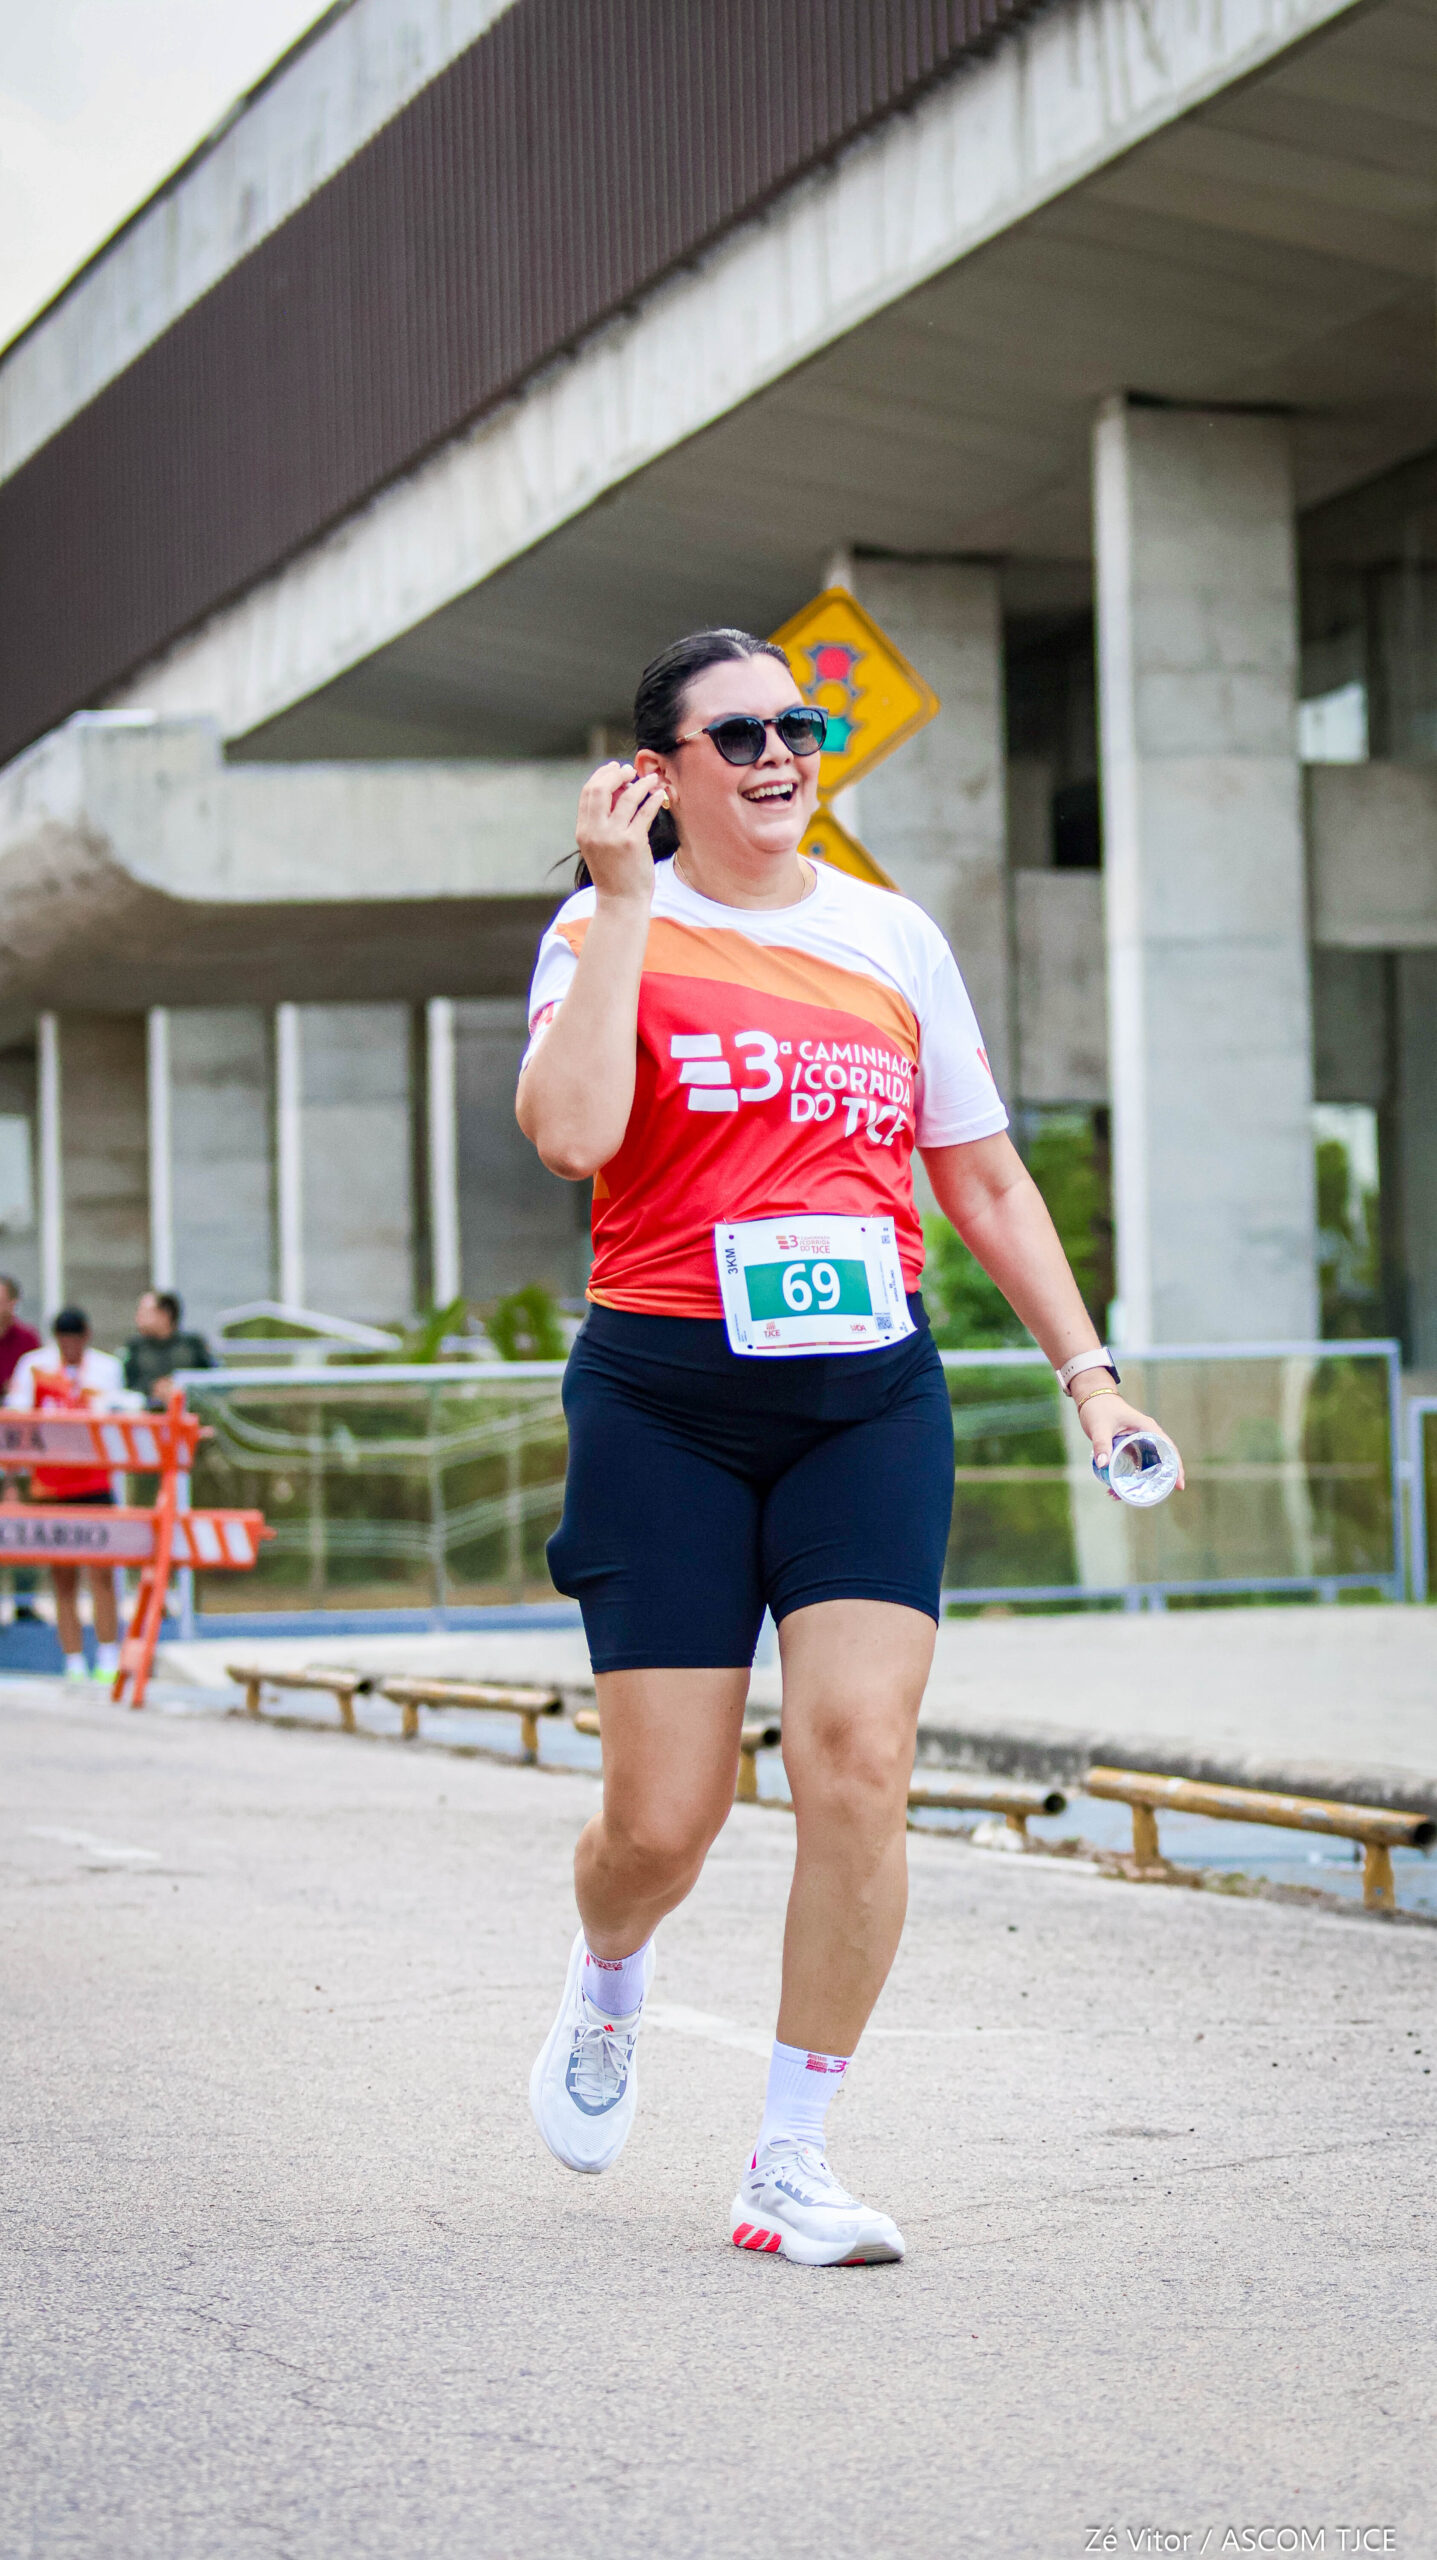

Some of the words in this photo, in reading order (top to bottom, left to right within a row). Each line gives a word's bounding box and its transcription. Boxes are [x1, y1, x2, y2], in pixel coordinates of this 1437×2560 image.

[735, 1030, 792, 1103] 3ª
[790, 1092, 836, 1123] DO
[725, 1248, 738, 1275] 3KM
[811, 1245, 831, 1254] TJCE
[782, 1262, 841, 1312] 69
[764, 1330, 781, 1338] TJCE
